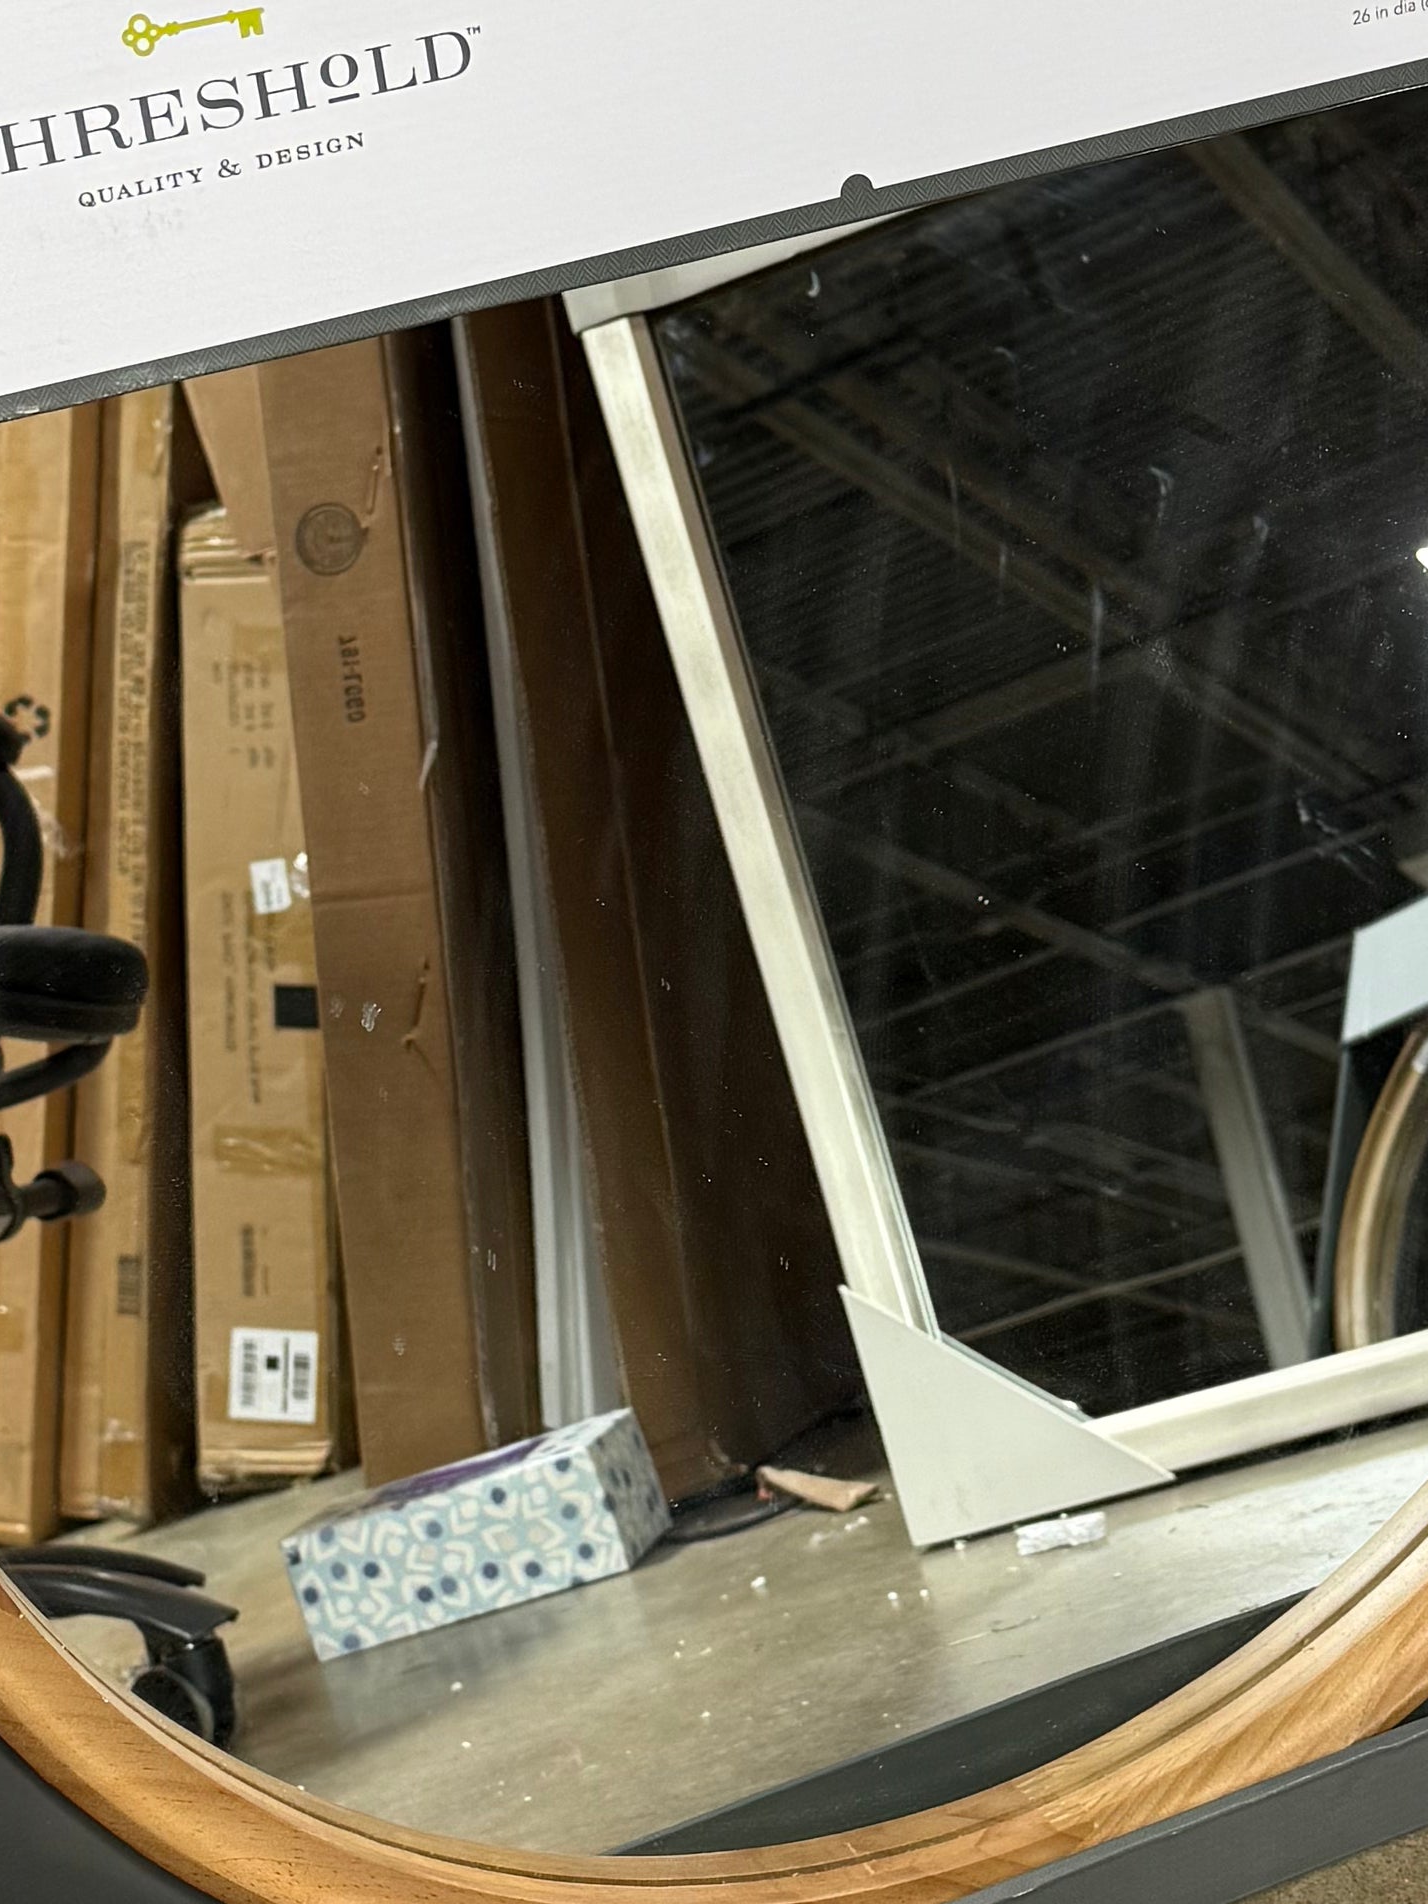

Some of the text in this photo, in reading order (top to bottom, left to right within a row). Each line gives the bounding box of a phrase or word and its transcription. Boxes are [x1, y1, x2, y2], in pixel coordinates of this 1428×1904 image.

[1352, 8, 1371, 26] 26
[1375, 6, 1389, 21] in
[78, 132, 366, 208] QUALITY & DESIGN
